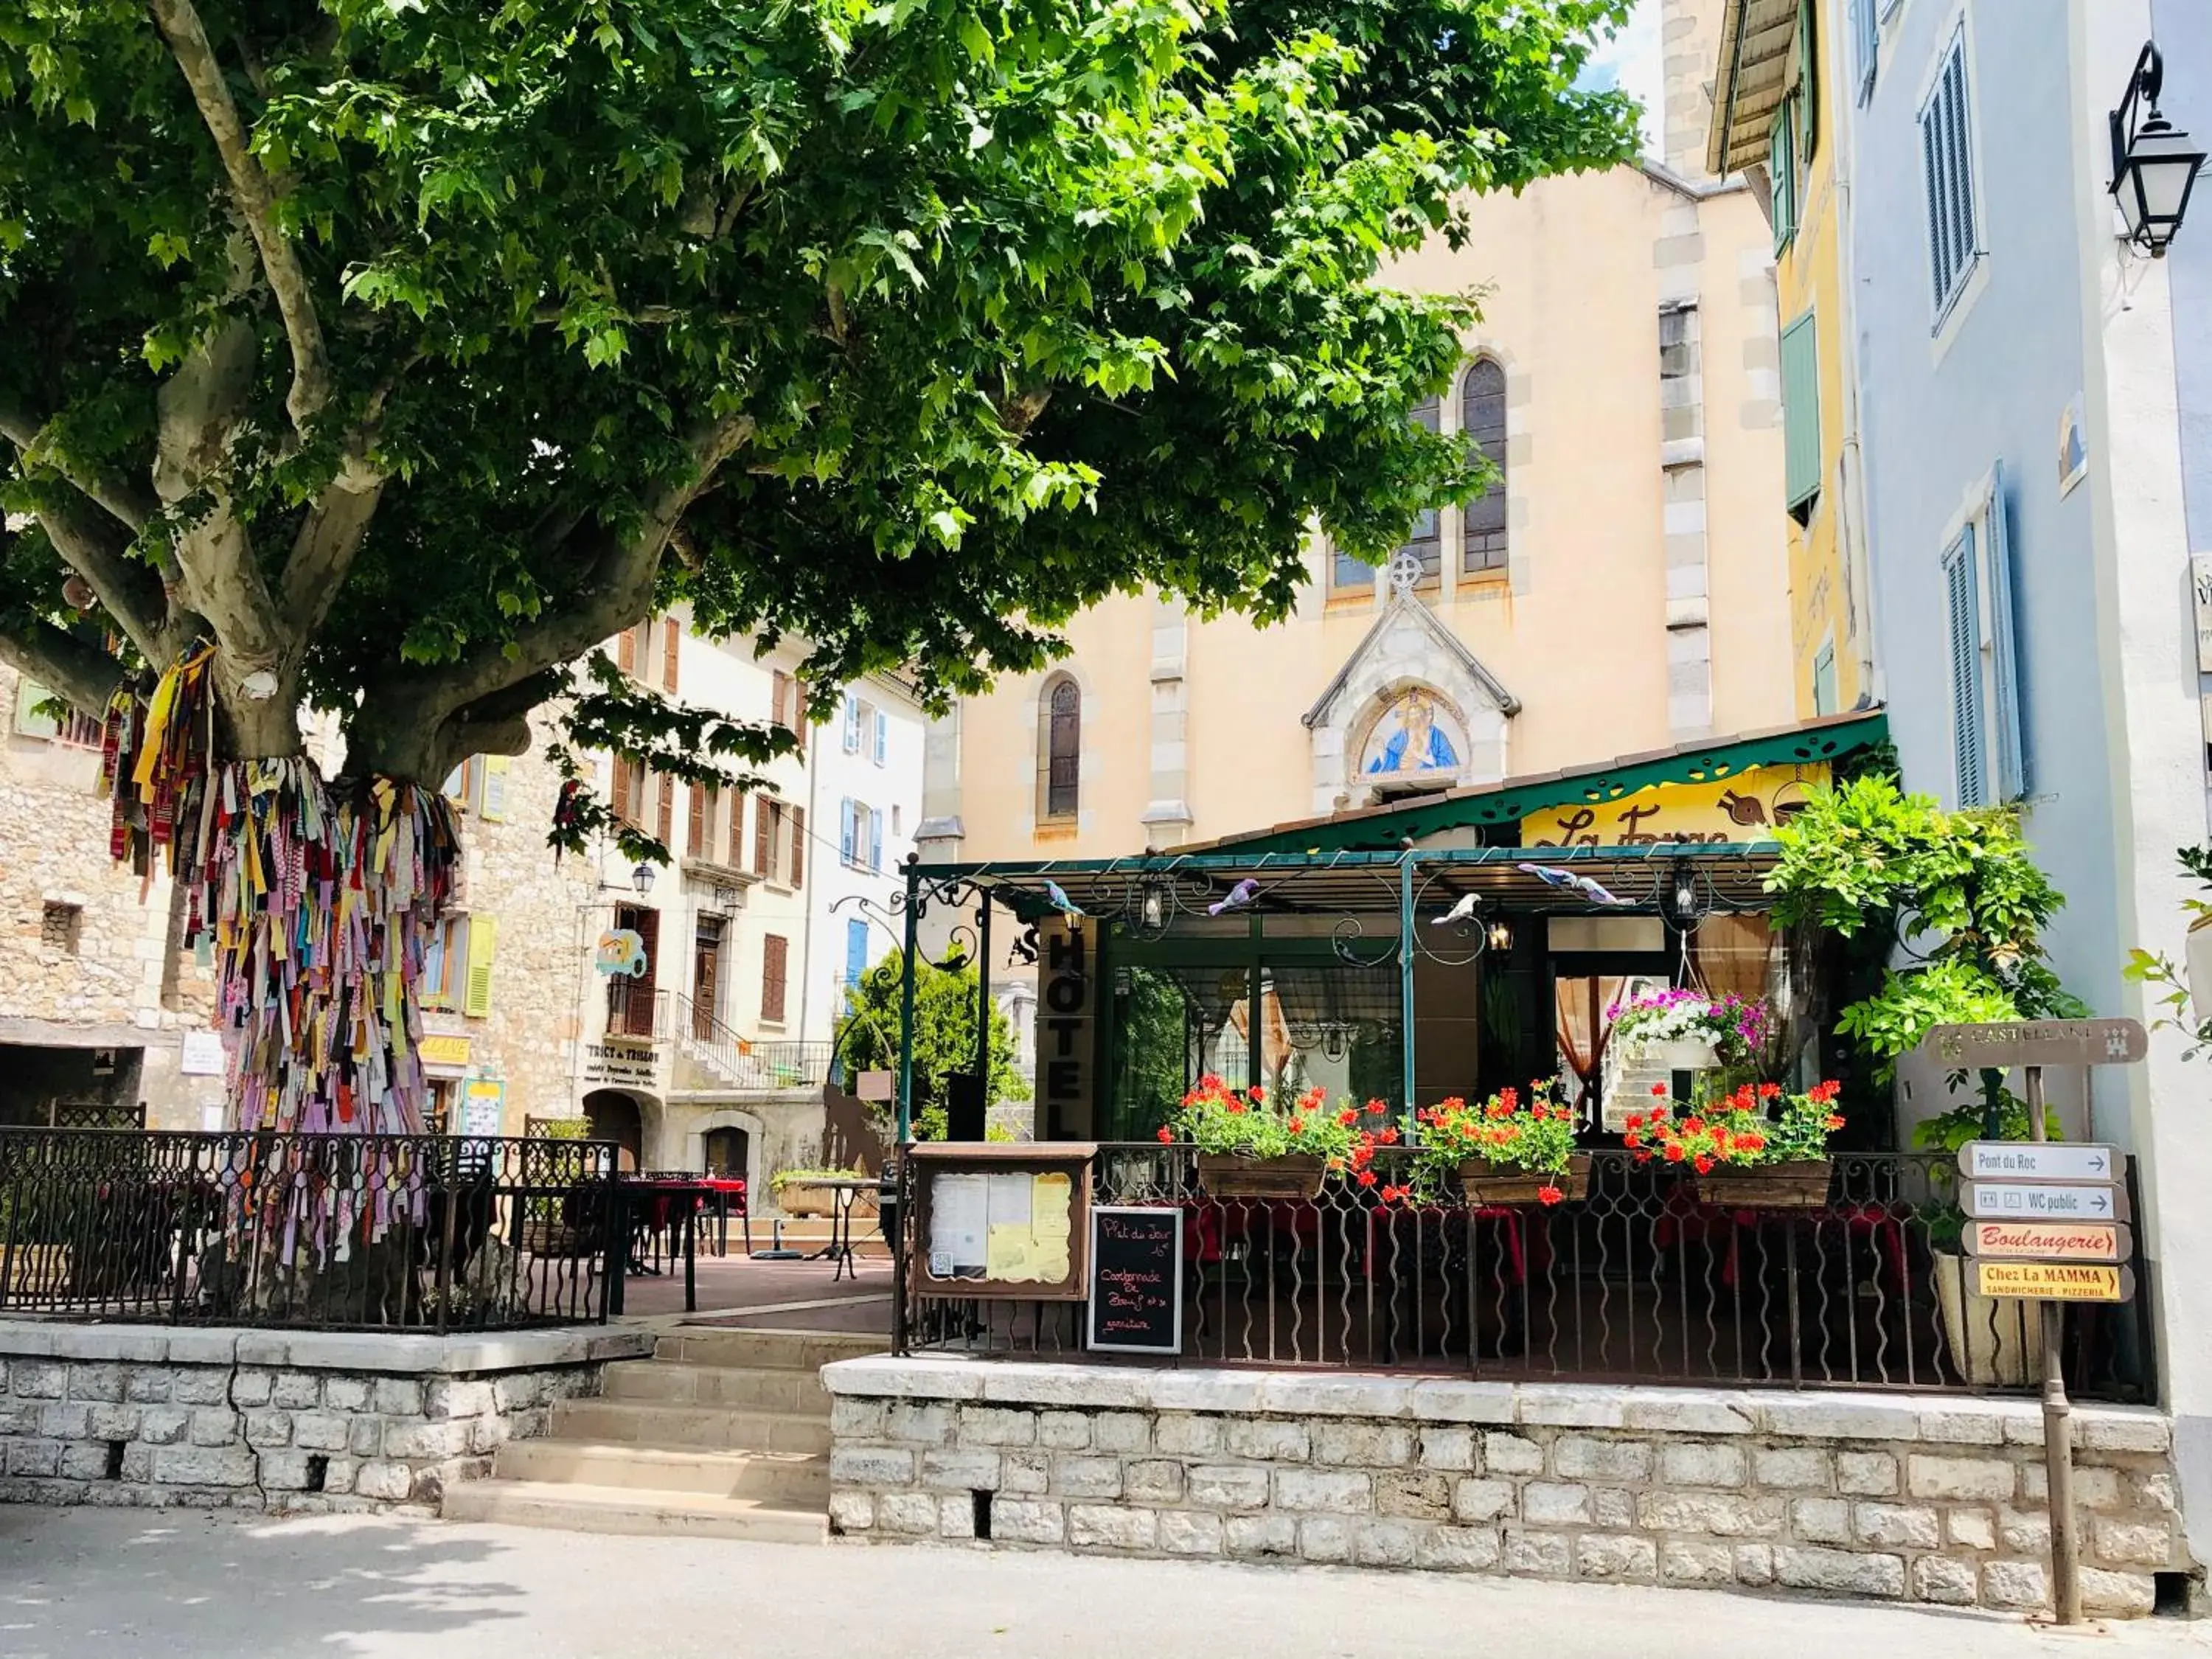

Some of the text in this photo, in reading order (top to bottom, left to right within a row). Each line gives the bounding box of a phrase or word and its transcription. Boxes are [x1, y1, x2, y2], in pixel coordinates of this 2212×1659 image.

[1046, 933, 1086, 1142] HOTEL
[1978, 1152, 2037, 1170] Pont du Roc
[2028, 1192, 2079, 1214] WC public
[1981, 1226, 2104, 1254] Boulangerie
[1986, 1267, 2101, 1284] Chez La MAMMA
[1986, 1284, 2054, 1295] SANDWICHERIE
[2062, 1287, 2104, 1297] PIZZERIA
